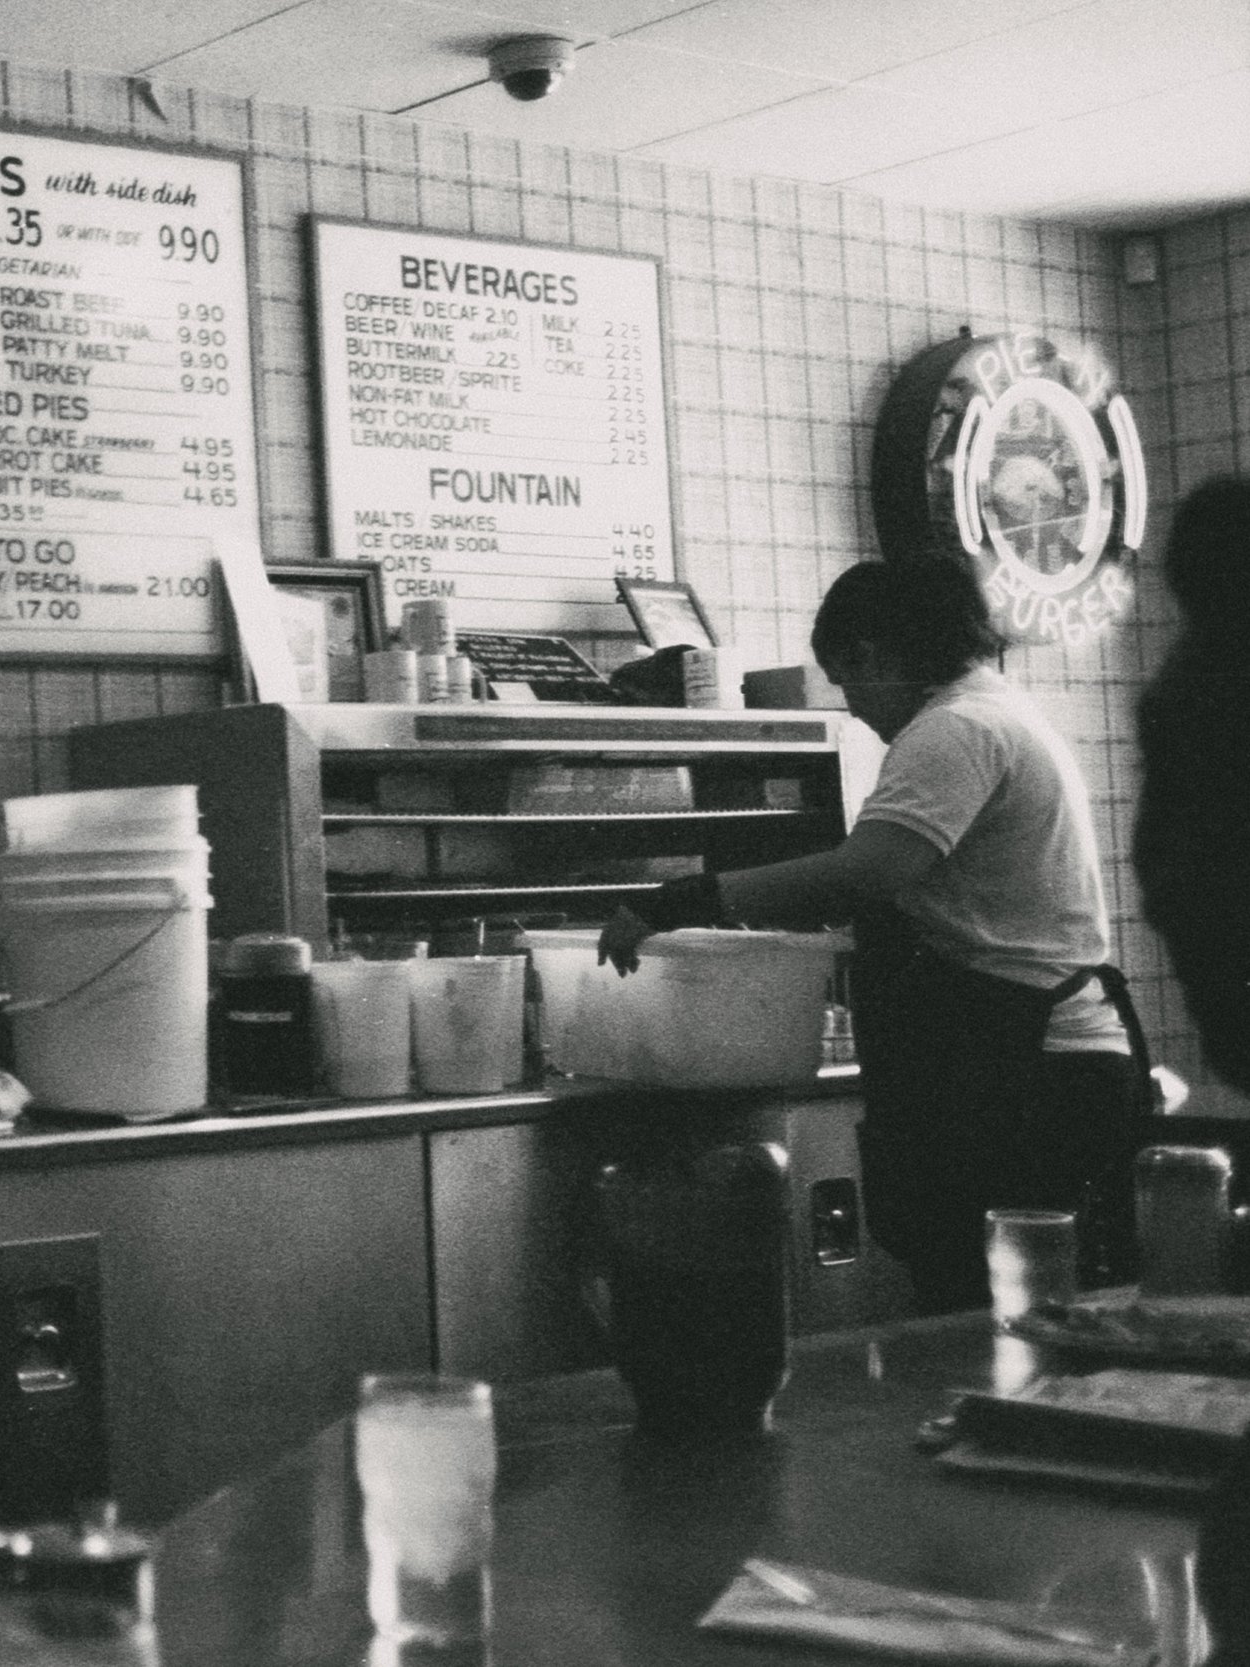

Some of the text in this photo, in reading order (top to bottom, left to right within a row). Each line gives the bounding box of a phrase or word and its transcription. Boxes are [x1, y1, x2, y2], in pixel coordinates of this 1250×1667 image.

[46, 173, 97, 196] with
[105, 178, 149, 201] side
[152, 180, 197, 207] dish
[401, 255, 578, 305] BEVERAGES
[0, 286, 64, 310] ROAST
[0, 310, 89, 336] GRILLED
[423, 301, 479, 321] DECAF
[542, 313, 578, 333] MILK
[410, 321, 454, 342] WINE
[544, 335, 574, 352] TEA
[3, 335, 68, 357] PATTY
[76, 343, 130, 362] MELT
[346, 337, 456, 363] BUTTERMILK
[5, 360, 92, 385] TURKEY
[458, 371, 522, 392] SPRITE
[32, 393, 88, 421] PIES
[349, 385, 469, 409] NON-FAT MILK
[350, 407, 491, 434] HOT CHOCOLATE
[27, 426, 77, 448] CAKE
[351, 428, 453, 452] LEMONADE
[52, 452, 102, 474] CAKE
[31, 478, 72, 498] PIES
[430, 467, 581, 508] FOUNTAIN
[354, 510, 497, 532] MALTS SHAKES
[35, 539, 76, 565] GO
[357, 532, 500, 553] ICE CREAM SODA
[16, 571, 80, 593] PEACH
[393, 578, 456, 598] CREAM
